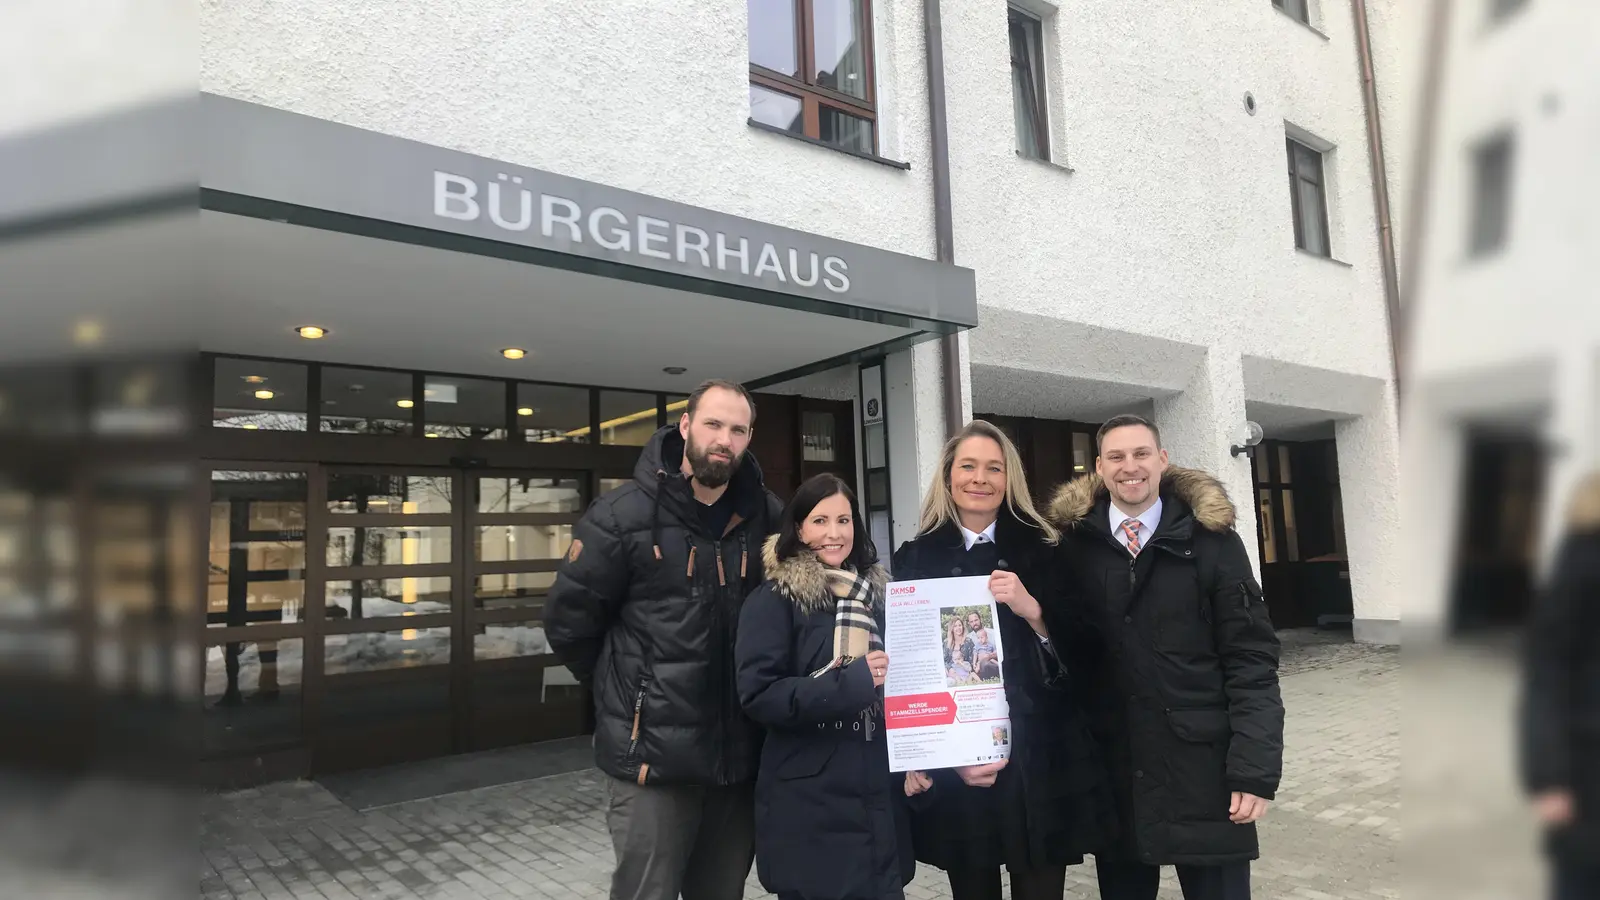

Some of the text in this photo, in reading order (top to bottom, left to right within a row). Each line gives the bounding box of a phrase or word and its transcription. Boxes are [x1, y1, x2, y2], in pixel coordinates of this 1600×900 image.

[433, 170, 851, 293] BÜRGERHAUS
[890, 586, 910, 595] DKMS
[889, 706, 948, 716] STAMMZELLSPENDER!
